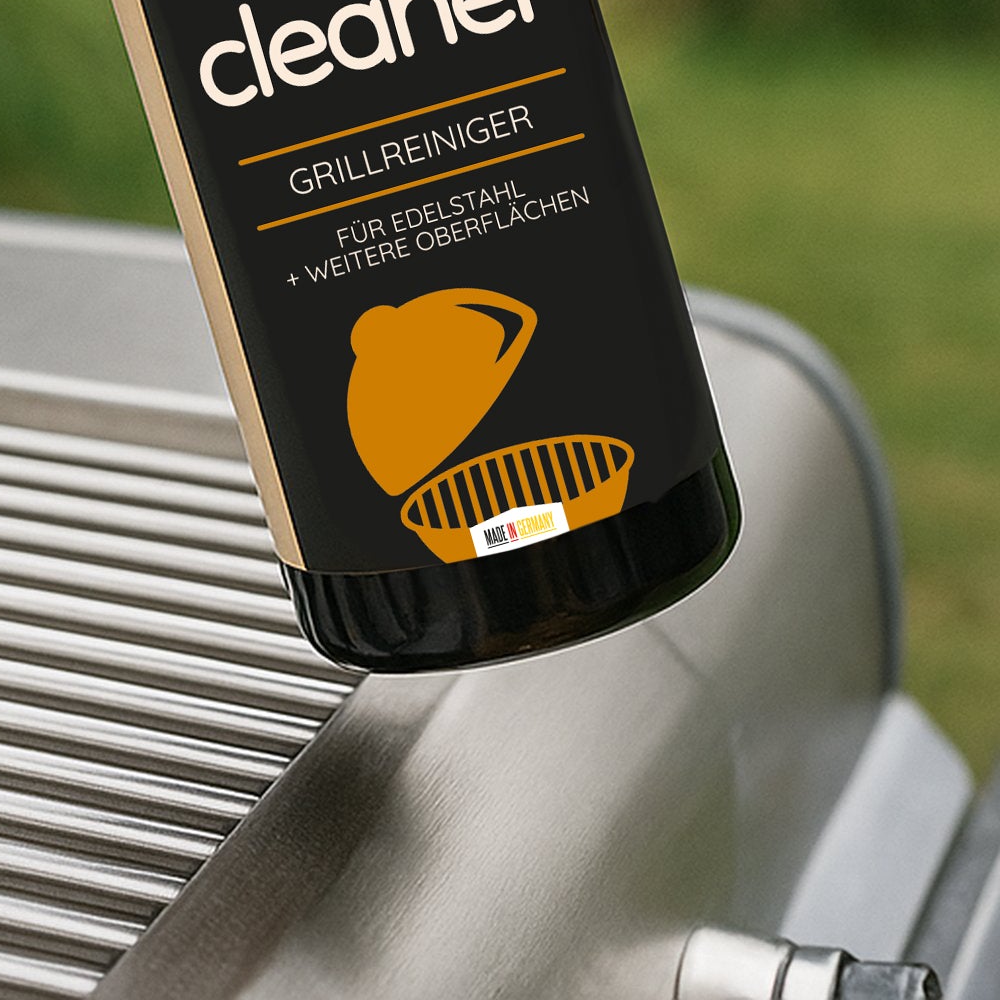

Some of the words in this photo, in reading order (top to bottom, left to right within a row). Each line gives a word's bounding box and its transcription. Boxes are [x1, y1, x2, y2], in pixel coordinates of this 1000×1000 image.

[289, 104, 534, 195] GRILLREINIGER
[304, 237, 411, 283] WEITERE
[415, 186, 590, 252] OBERFLÄCHEN
[336, 218, 386, 249] FÜR
[393, 180, 526, 233] EDELSTAHL
[483, 525, 508, 546] MADE
[506, 522, 518, 539] IN
[516, 511, 555, 537] GERMANY
